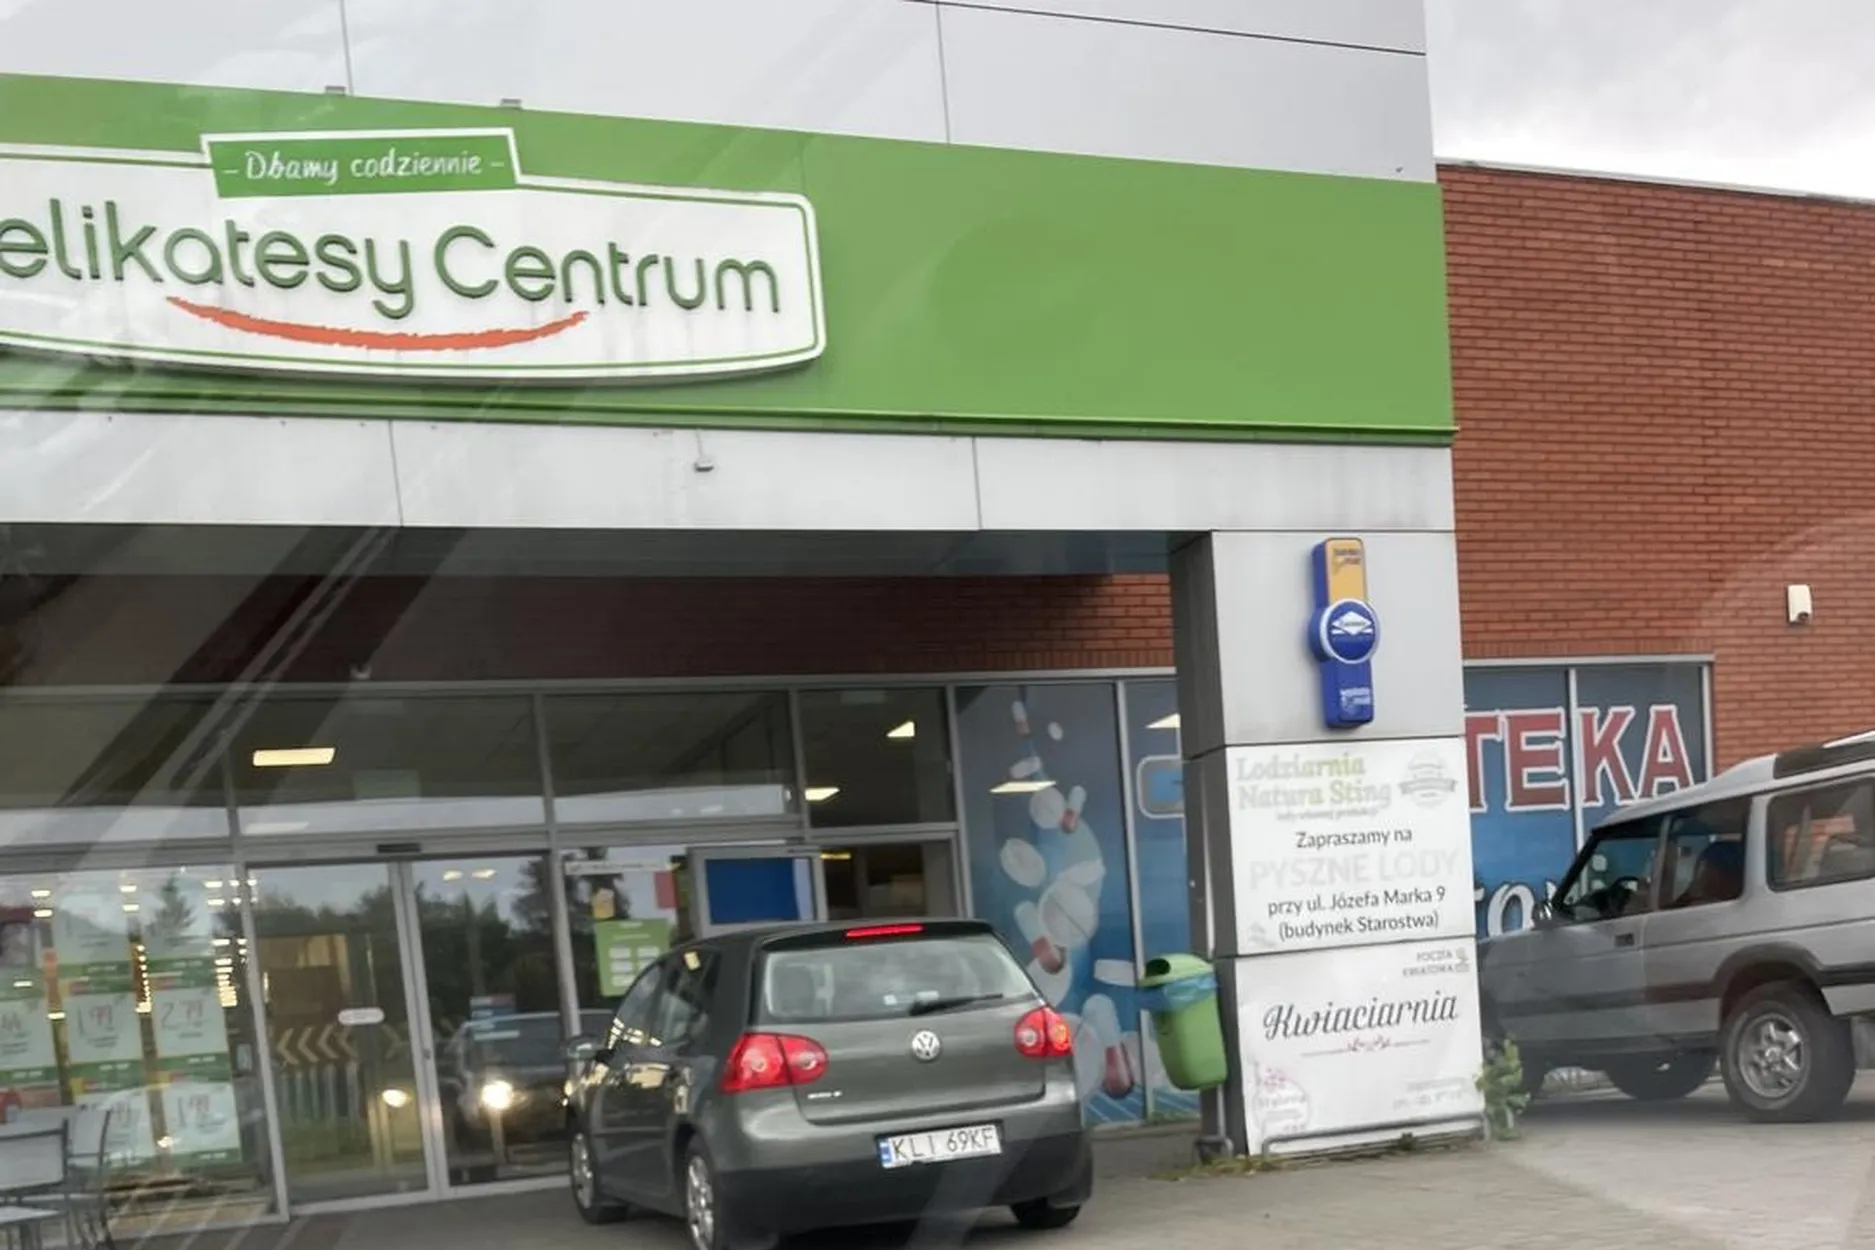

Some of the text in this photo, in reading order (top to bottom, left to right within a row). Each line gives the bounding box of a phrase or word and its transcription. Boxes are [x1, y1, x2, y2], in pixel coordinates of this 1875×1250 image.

[245, 148, 482, 186] Dbamy codziennie
[0, 199, 780, 319] elikatesy Centrum
[1238, 785, 1324, 810] Natura
[1295, 829, 1412, 850] Zapraszamy na
[1249, 849, 1459, 889] PYSZNE LODY
[1268, 885, 1446, 917] przy ul. Józefa Marka 9
[1278, 911, 1440, 942] (budynek Starostwa)
[1263, 990, 1459, 1041] Kwiaciarnia
[946, 1126, 994, 1153] 69KF
